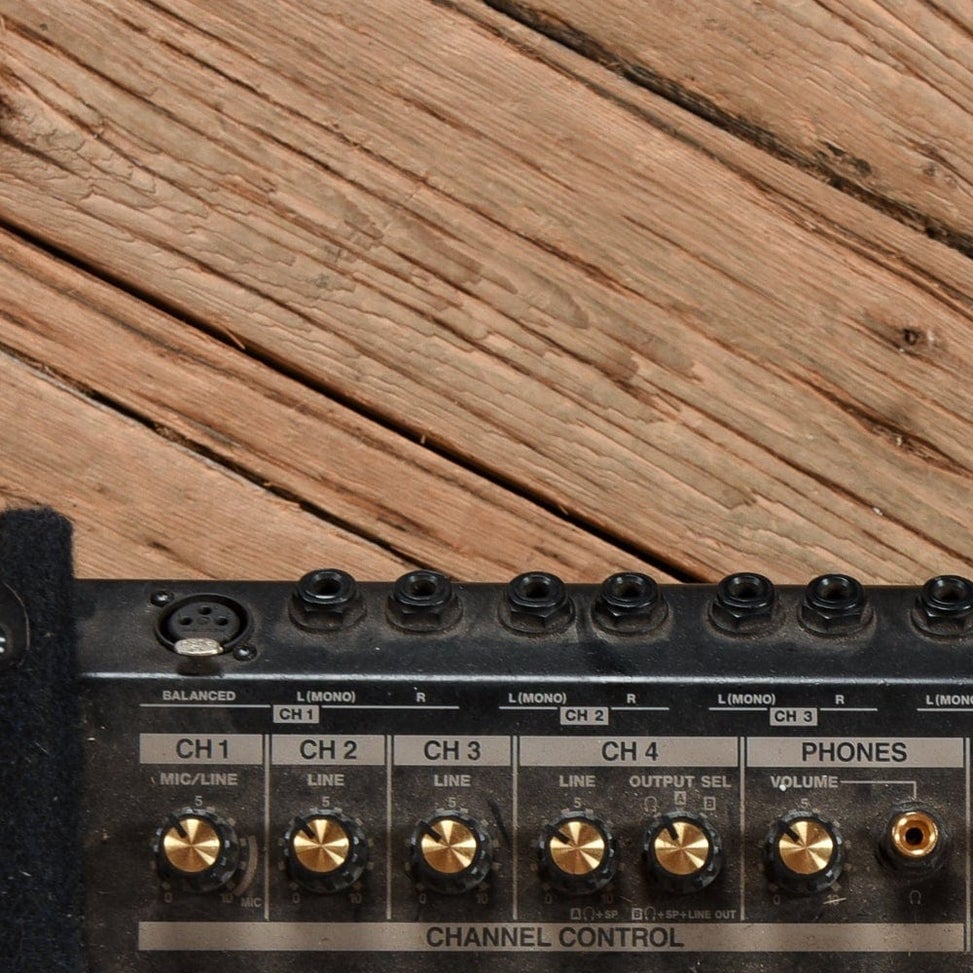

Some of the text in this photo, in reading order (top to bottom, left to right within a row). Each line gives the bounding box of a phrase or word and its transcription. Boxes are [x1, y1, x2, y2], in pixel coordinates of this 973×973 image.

[163, 691, 235, 700] BALANCED
[417, 693, 425, 701] R
[628, 694, 635, 703] R
[836, 695, 844, 704] R
[280, 708, 312, 720] CH 1
[565, 709, 603, 721] CH 2
[775, 710, 812, 722] CH 3
[176, 739, 227, 758] CH 1
[300, 740, 356, 759] CH 2
[424, 740, 480, 760] CH 3
[602, 741, 658, 761] CH 4
[802, 742, 907, 762] PHONES
[161, 773, 237, 785] MIC/LINE
[308, 774, 344, 785] LINE
[434, 775, 470, 786] LINE
[560, 775, 595, 787] LINE
[629, 775, 731, 787] OUTPUT SEL
[770, 776, 838, 789] VOLUME
[196, 796, 202, 806] 5
[323, 797, 329, 806] 5
[448, 797, 456, 807] 5
[574, 797, 581, 808] 5
[242, 898, 261, 907] MIC
[715, 910, 736, 919] OUT
[426, 927, 684, 947] CHANNEL CONTROL
